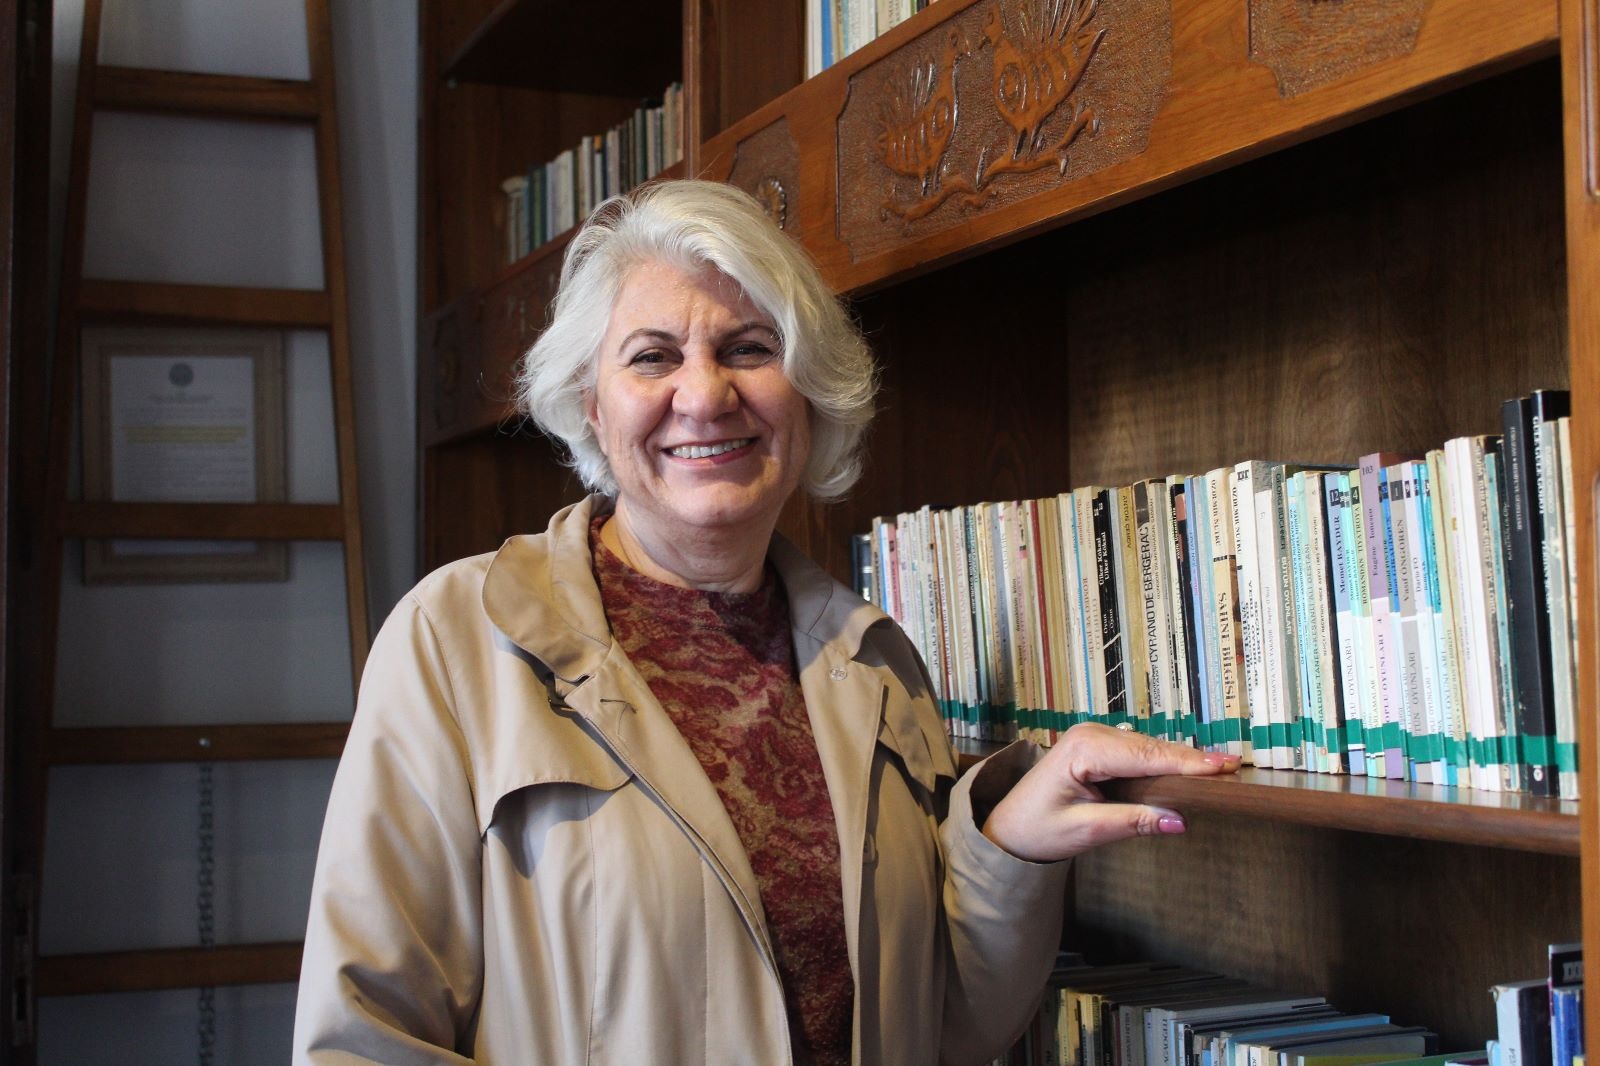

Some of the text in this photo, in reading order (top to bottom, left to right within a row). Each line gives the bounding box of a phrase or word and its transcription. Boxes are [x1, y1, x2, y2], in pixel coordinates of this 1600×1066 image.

[1275, 472, 1283, 507] GEORG
[1362, 465, 1374, 475] 103
[1122, 495, 1130, 522] ANTON
[1330, 489, 1339, 505] 12
[1097, 564, 1105, 586] Ülker
[1304, 542, 1313, 585] DESTANI
[1333, 514, 1347, 595] Memet BAYDUR
[927, 573, 936, 624] CAESAR
[1140, 525, 1159, 663] CYRANO DE BERGERAC
[1359, 557, 1367, 606] ROMANDAN
[1092, 598, 1101, 651] OTHELLO
[1218, 591, 1229, 643] SAHNE
[1223, 645, 1235, 701] BİLGİSİ
[1313, 648, 1321, 680] TANER
[1378, 633, 1387, 692] OYUNLARI
[1408, 651, 1418, 706] OYUNLARI
[1316, 681, 1324, 723] HALDUN
